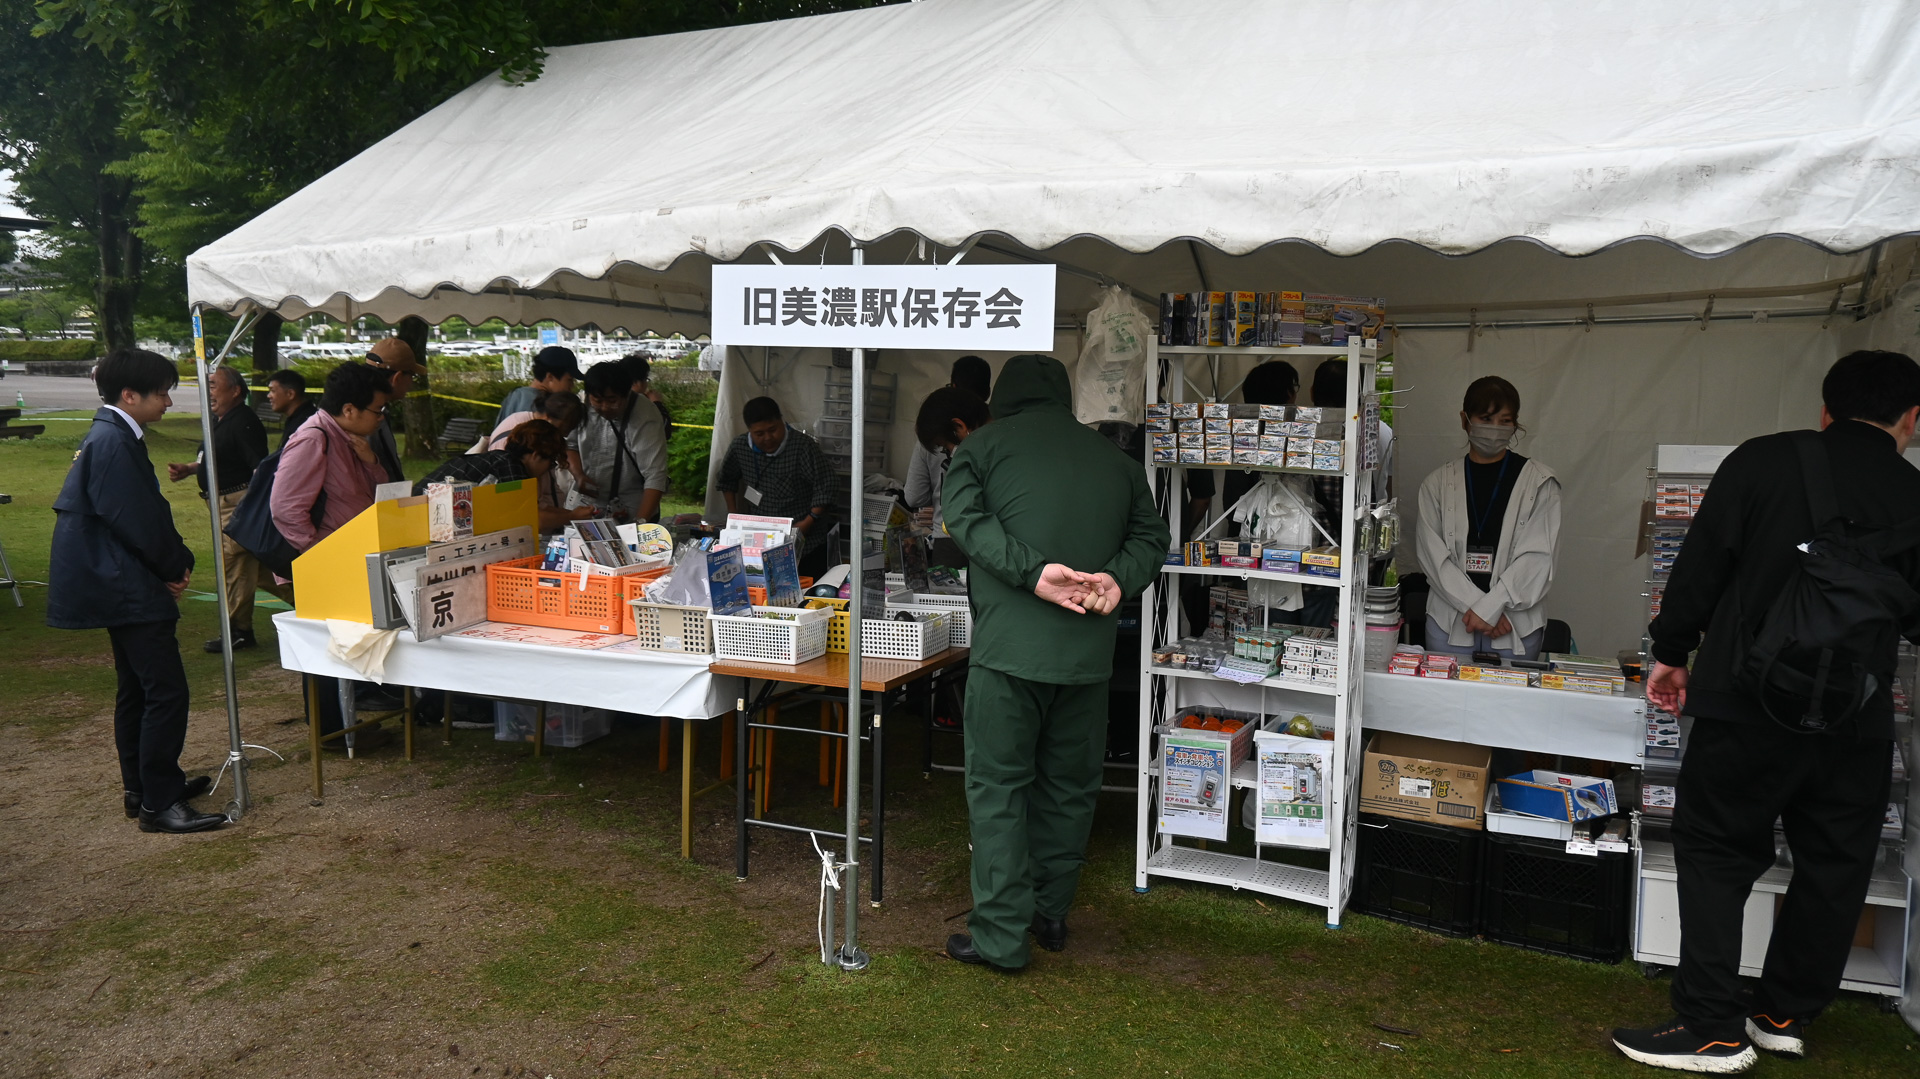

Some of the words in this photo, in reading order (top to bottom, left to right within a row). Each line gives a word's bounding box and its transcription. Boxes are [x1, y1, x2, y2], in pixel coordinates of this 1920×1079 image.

[743, 286, 1024, 329] 旧美濃駅保存会
[430, 590, 454, 629] 京
[1403, 764, 1448, 777] ペヤング
[1374, 794, 1420, 806] まるか食品株式会社
